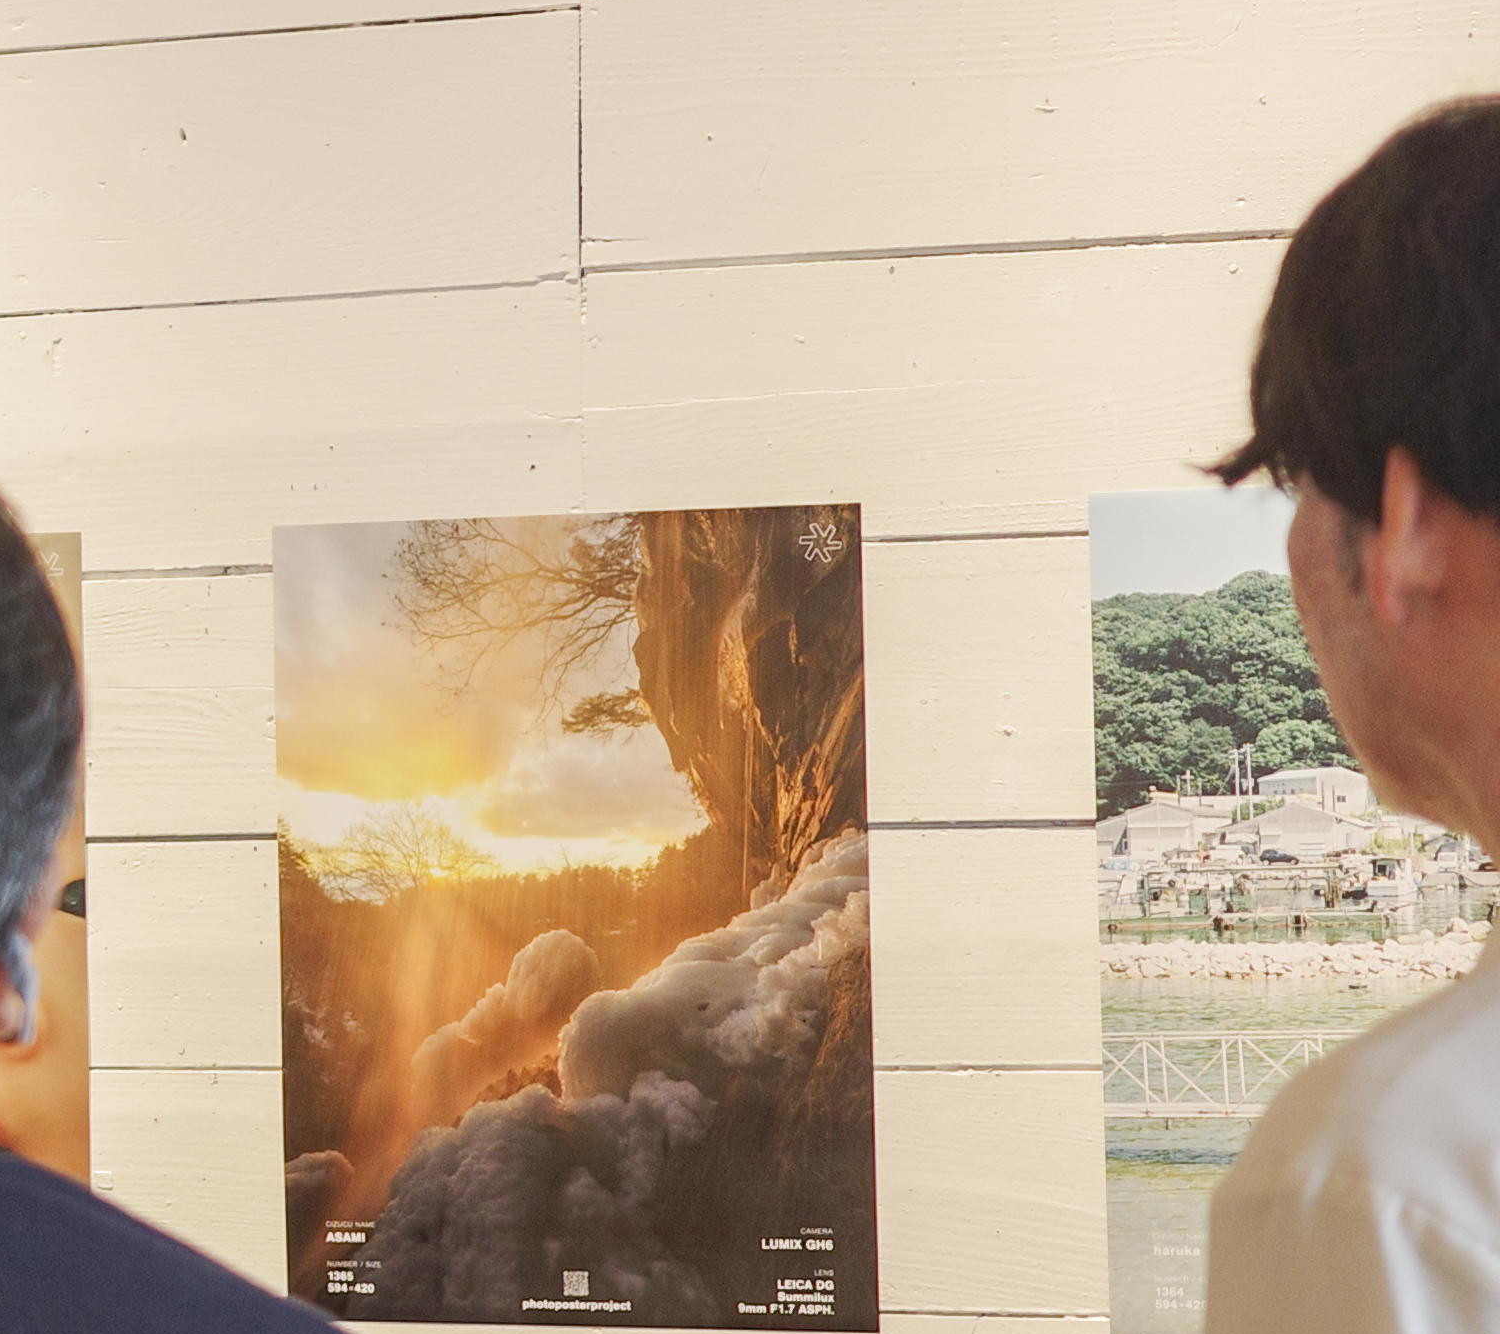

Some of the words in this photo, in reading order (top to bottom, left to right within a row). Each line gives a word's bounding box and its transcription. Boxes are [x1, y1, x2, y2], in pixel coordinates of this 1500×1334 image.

[354, 1220, 376, 1228] NAME
[325, 1231, 366, 1243] ASAMI
[800, 1227, 834, 1235] CAMERA
[761, 1238, 803, 1250] LUMIX
[805, 1239, 834, 1251] GH6
[1153, 1245, 1201, 1256] haruka
[327, 1270, 354, 1282] 1365
[813, 1269, 835, 1277] LENS
[776, 1278, 813, 1290] LEICA
[815, 1279, 835, 1291] DG
[777, 1291, 835, 1303] Summilux
[1155, 1286, 1185, 1297] 1364
[522, 1298, 632, 1313] photoposterproject
[737, 1302, 767, 1314] 9mm
[769, 1303, 796, 1314] F1.7
[798, 1304, 836, 1316] ASPH.
